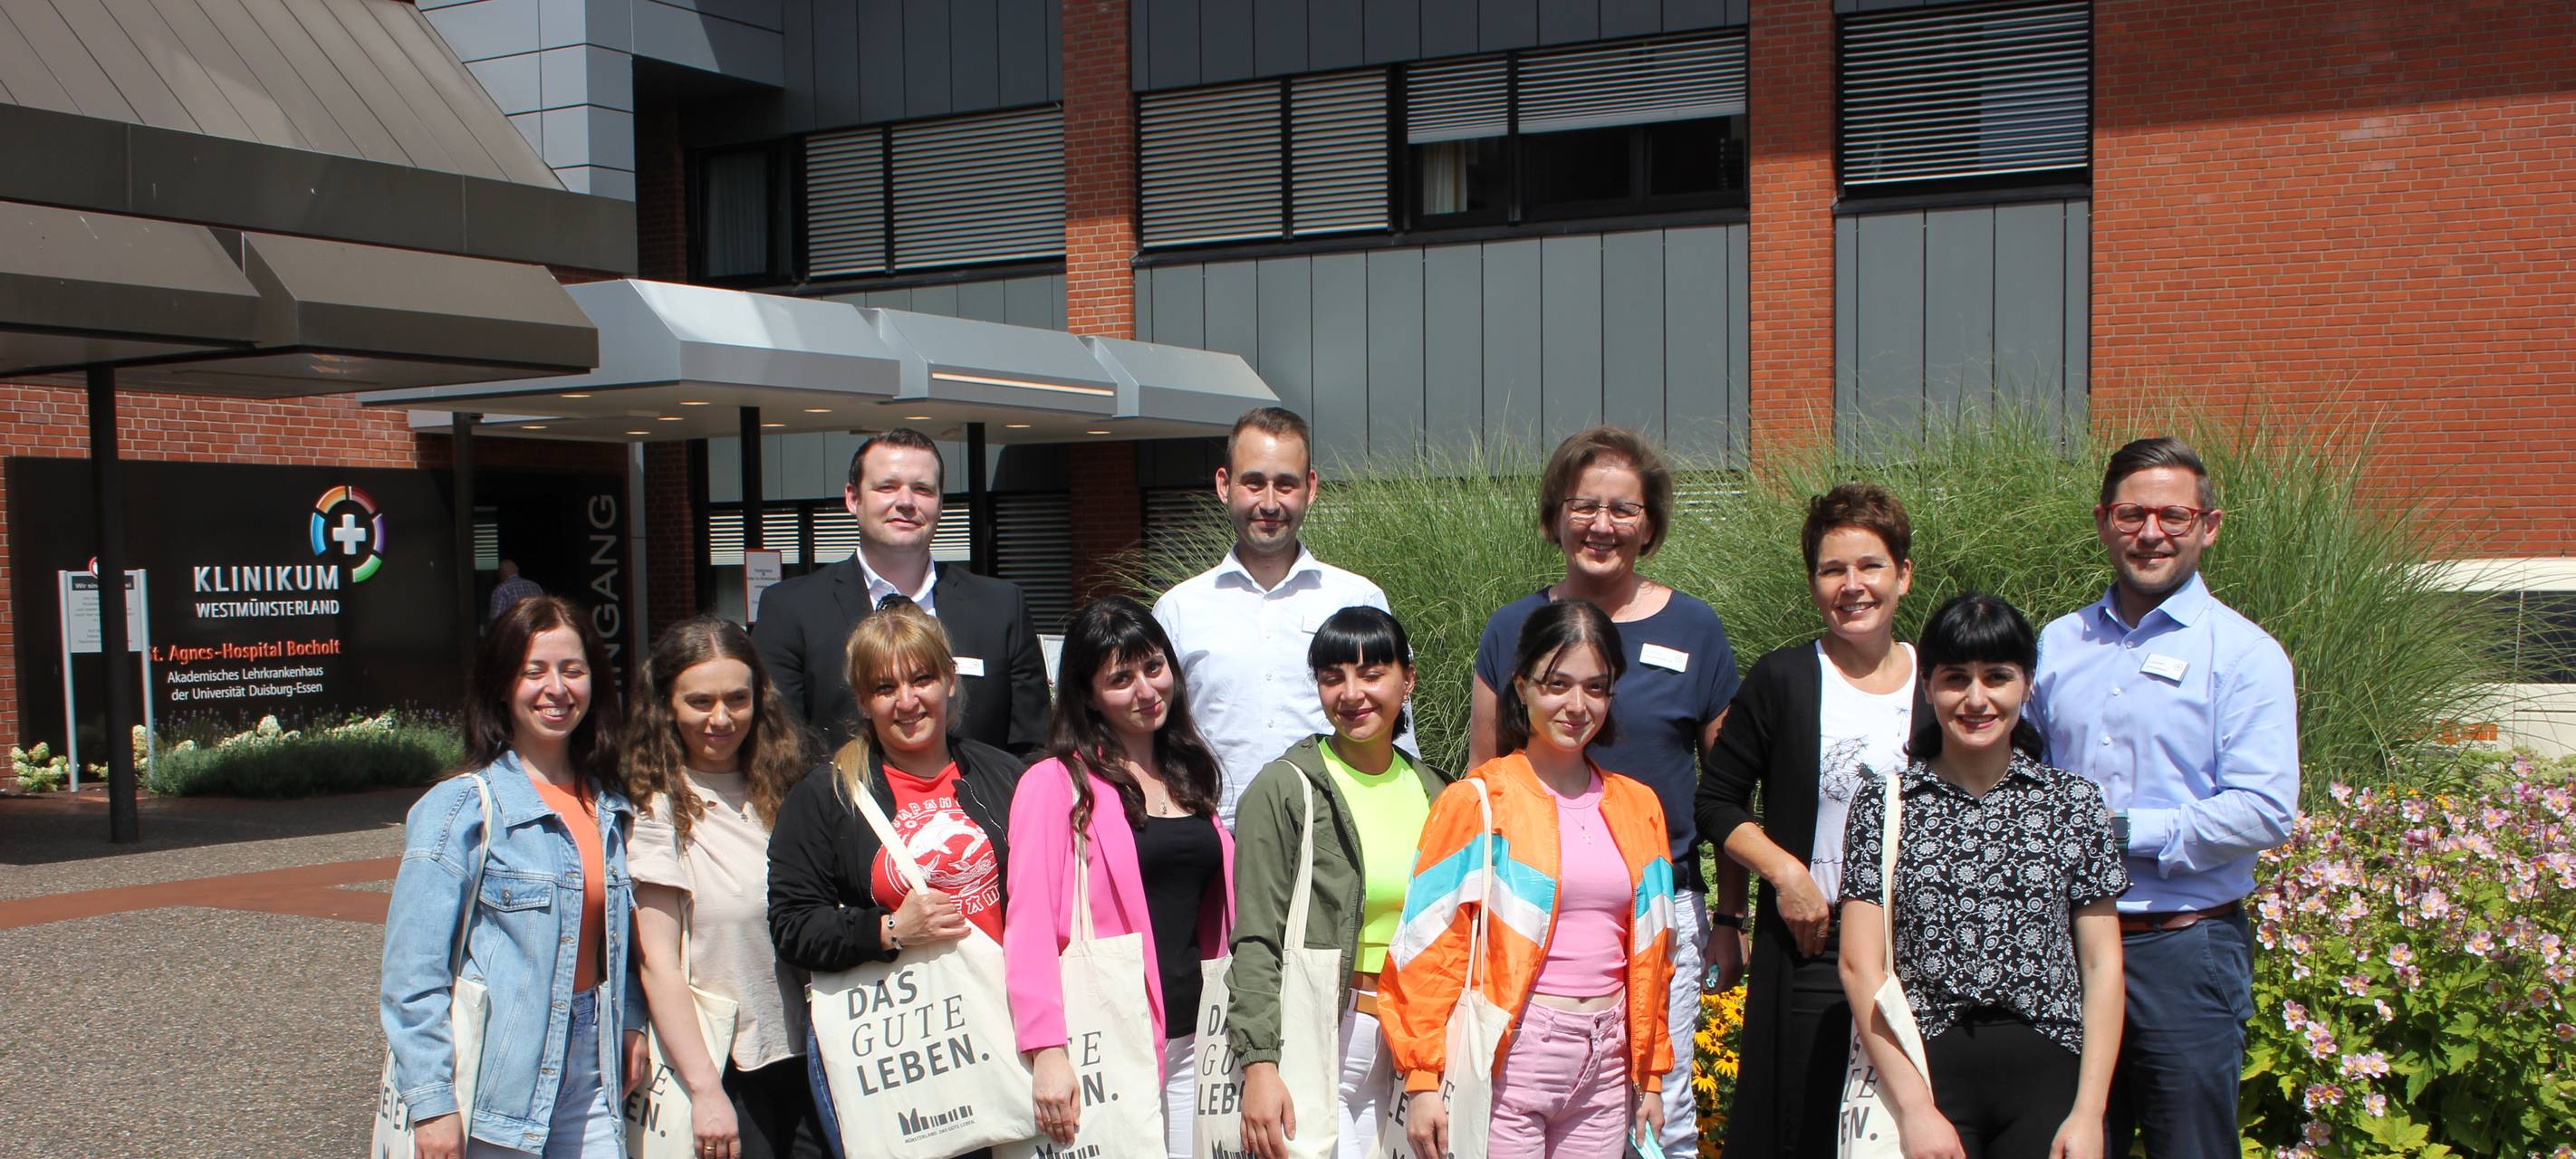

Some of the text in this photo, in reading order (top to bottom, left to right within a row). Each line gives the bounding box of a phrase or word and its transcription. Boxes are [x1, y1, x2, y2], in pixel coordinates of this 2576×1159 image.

[194, 565, 340, 592] KLINIKUM
[196, 599, 340, 618] WESTMÜNSTERLAND
[149, 638, 341, 665] t. Agnes-Hospital Bocholt
[168, 666, 324, 684] Akademisches Lehrkrankenhaus
[171, 682, 323, 701] der Universität Duisburg-Essen
[892, 797, 961, 829] JAPAN
[847, 971, 918, 1020] DAS
[851, 994, 966, 1057] GUTE
[857, 1034, 990, 1097] LEBEN.
[1202, 1043, 1236, 1077] GU
[623, 1091, 666, 1138] EN.
[1198, 1080, 1245, 1116] LEB
[1841, 1106, 1878, 1145] EN.
